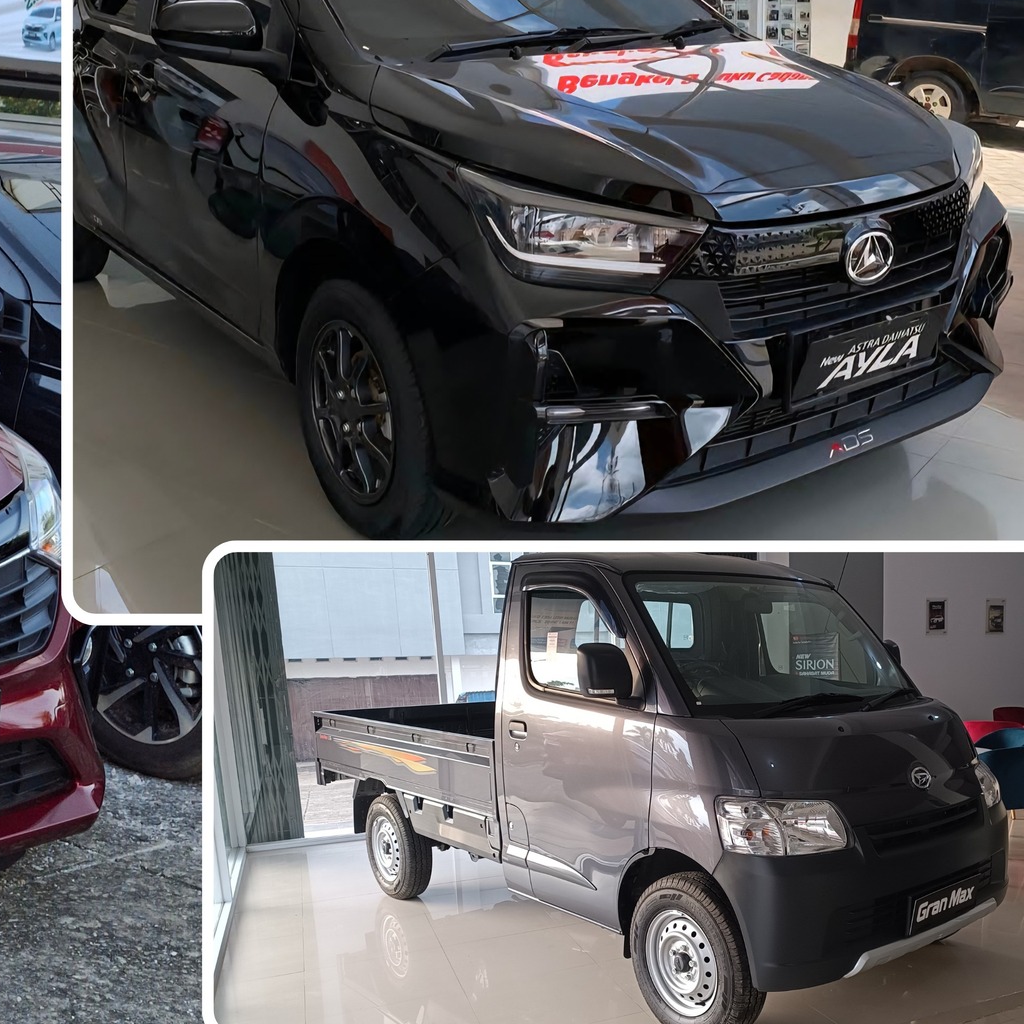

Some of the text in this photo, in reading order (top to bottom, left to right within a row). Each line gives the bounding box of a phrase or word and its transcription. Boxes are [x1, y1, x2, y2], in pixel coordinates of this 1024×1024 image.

[816, 333, 921, 390] AYLA
[819, 322, 926, 369] New ASTRA DAIHATSU
[795, 658, 835, 671] SIRION
[916, 885, 975, 923] Gran Max
